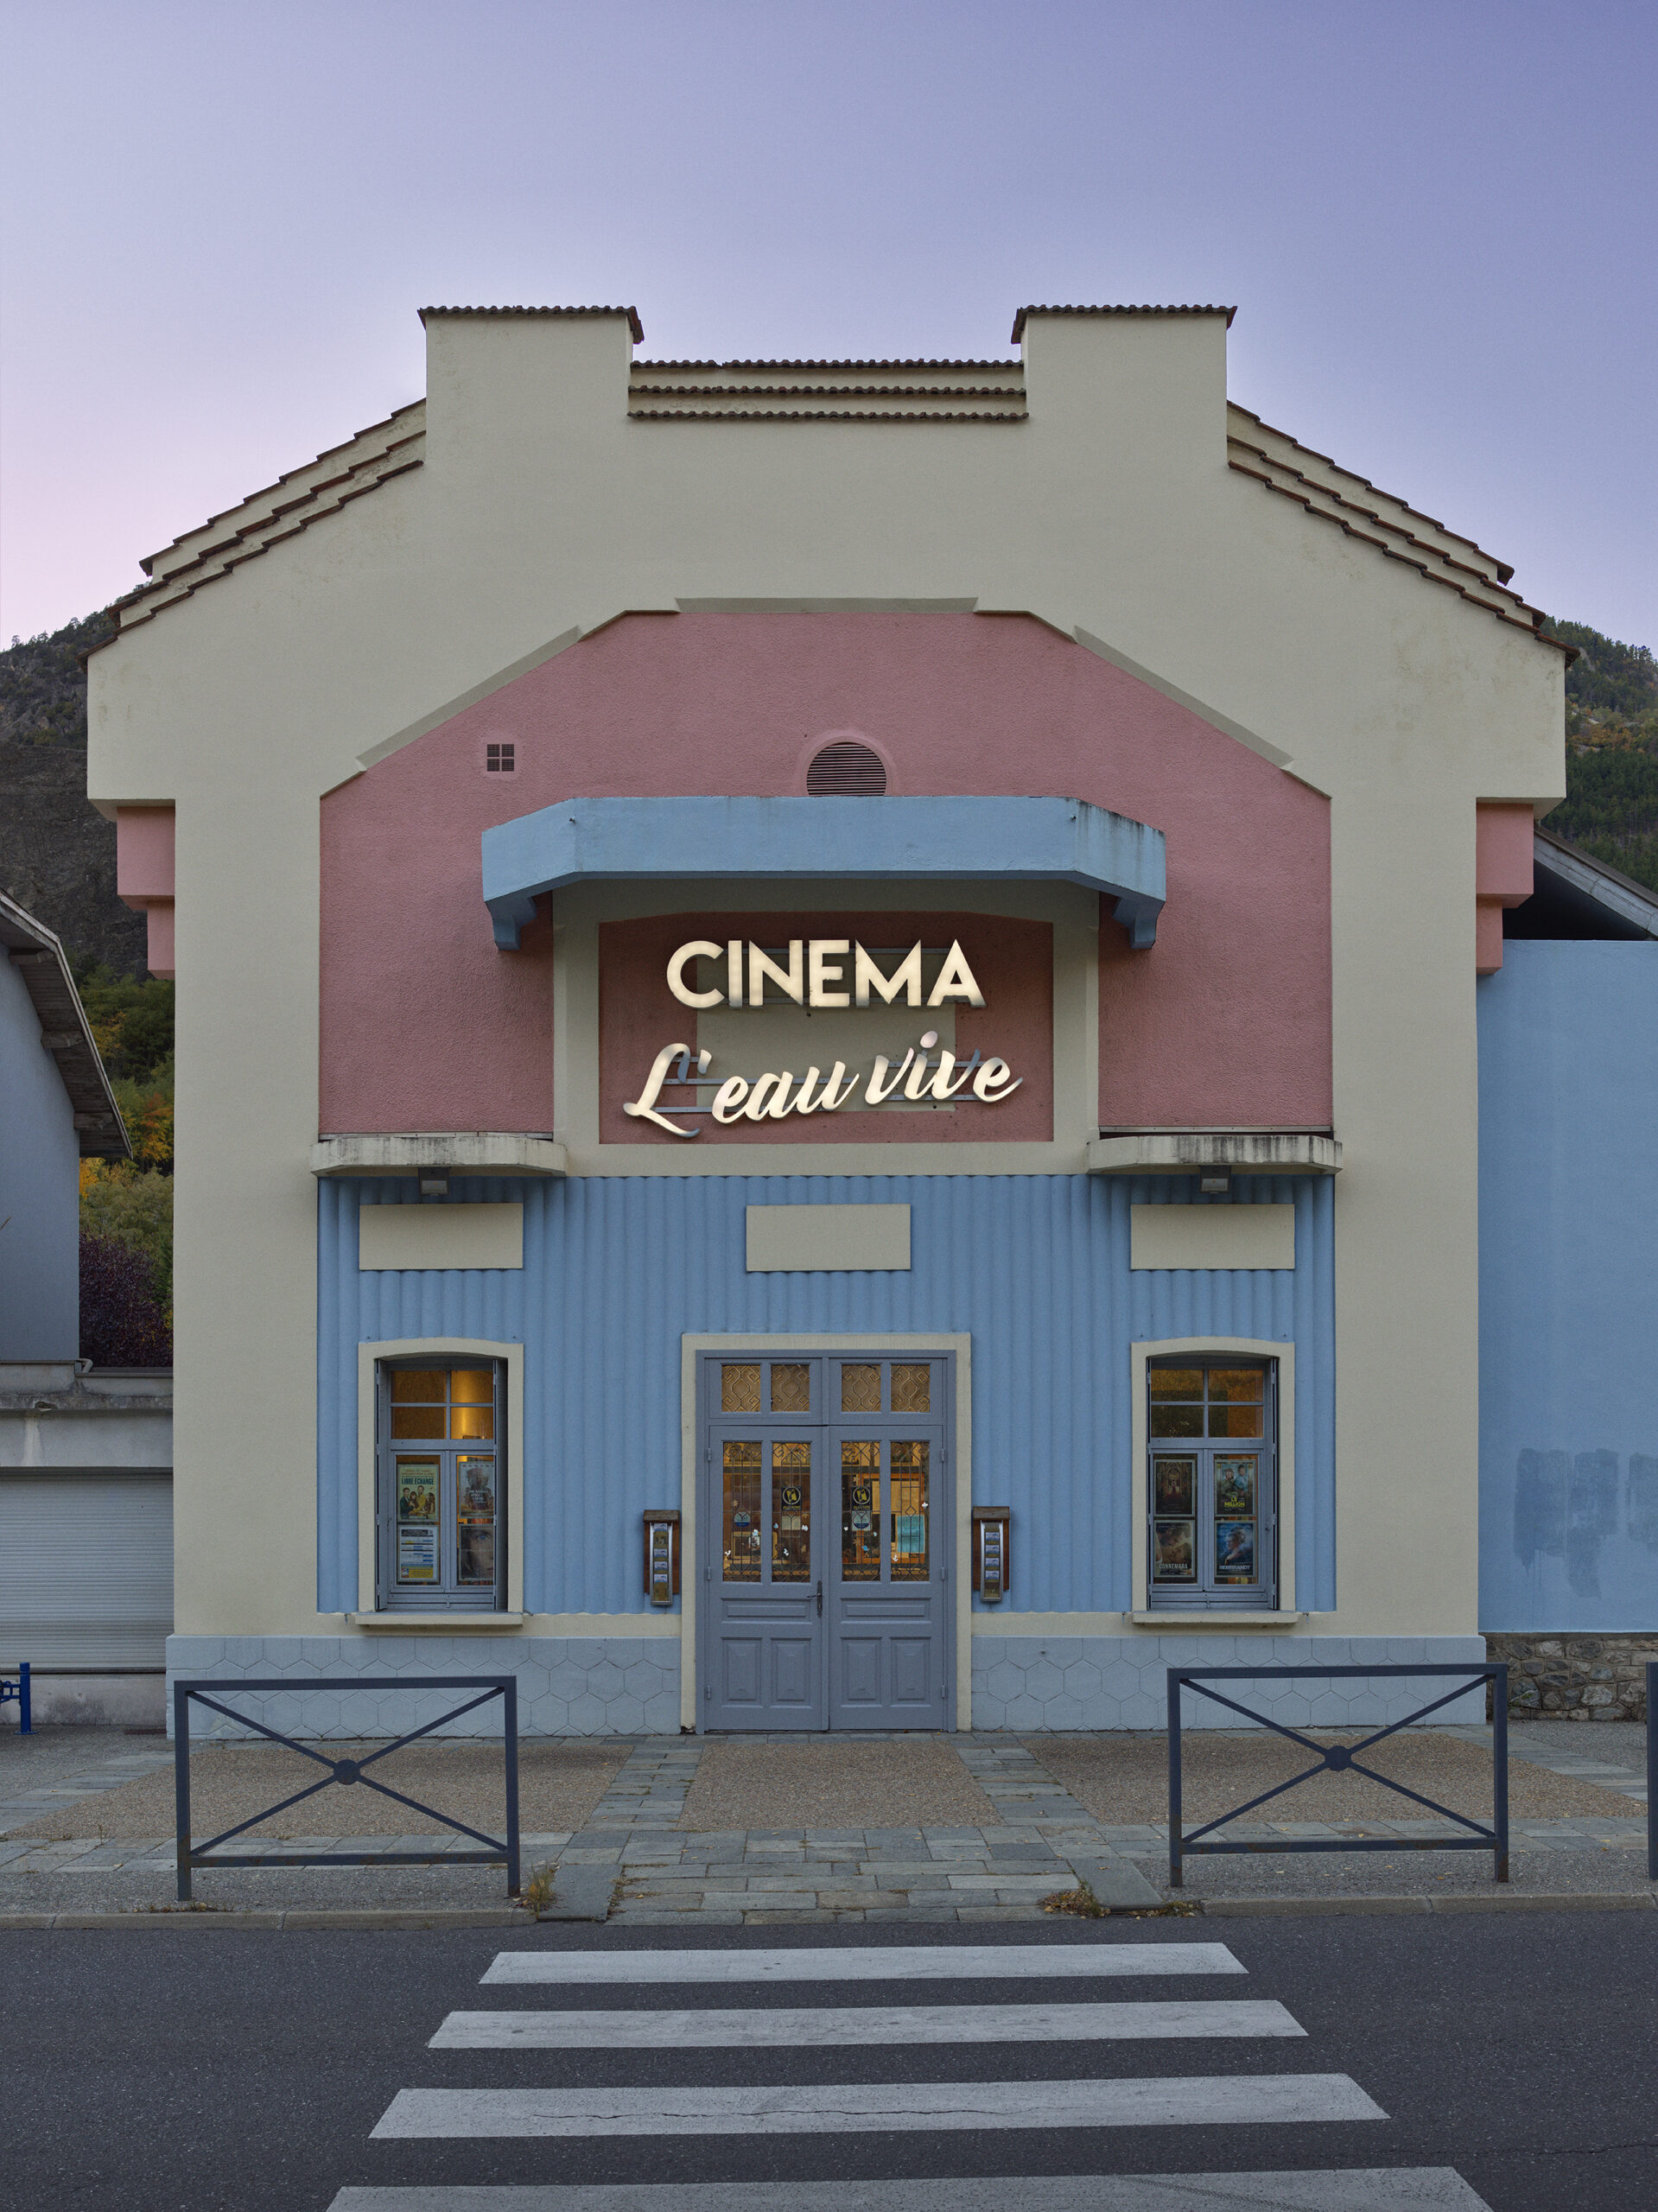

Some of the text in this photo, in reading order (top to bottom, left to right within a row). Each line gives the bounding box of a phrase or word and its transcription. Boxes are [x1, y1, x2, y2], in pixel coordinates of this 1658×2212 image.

[666, 938, 987, 1008] CINEMA
[623, 1030, 1024, 1138] L'eau vive
